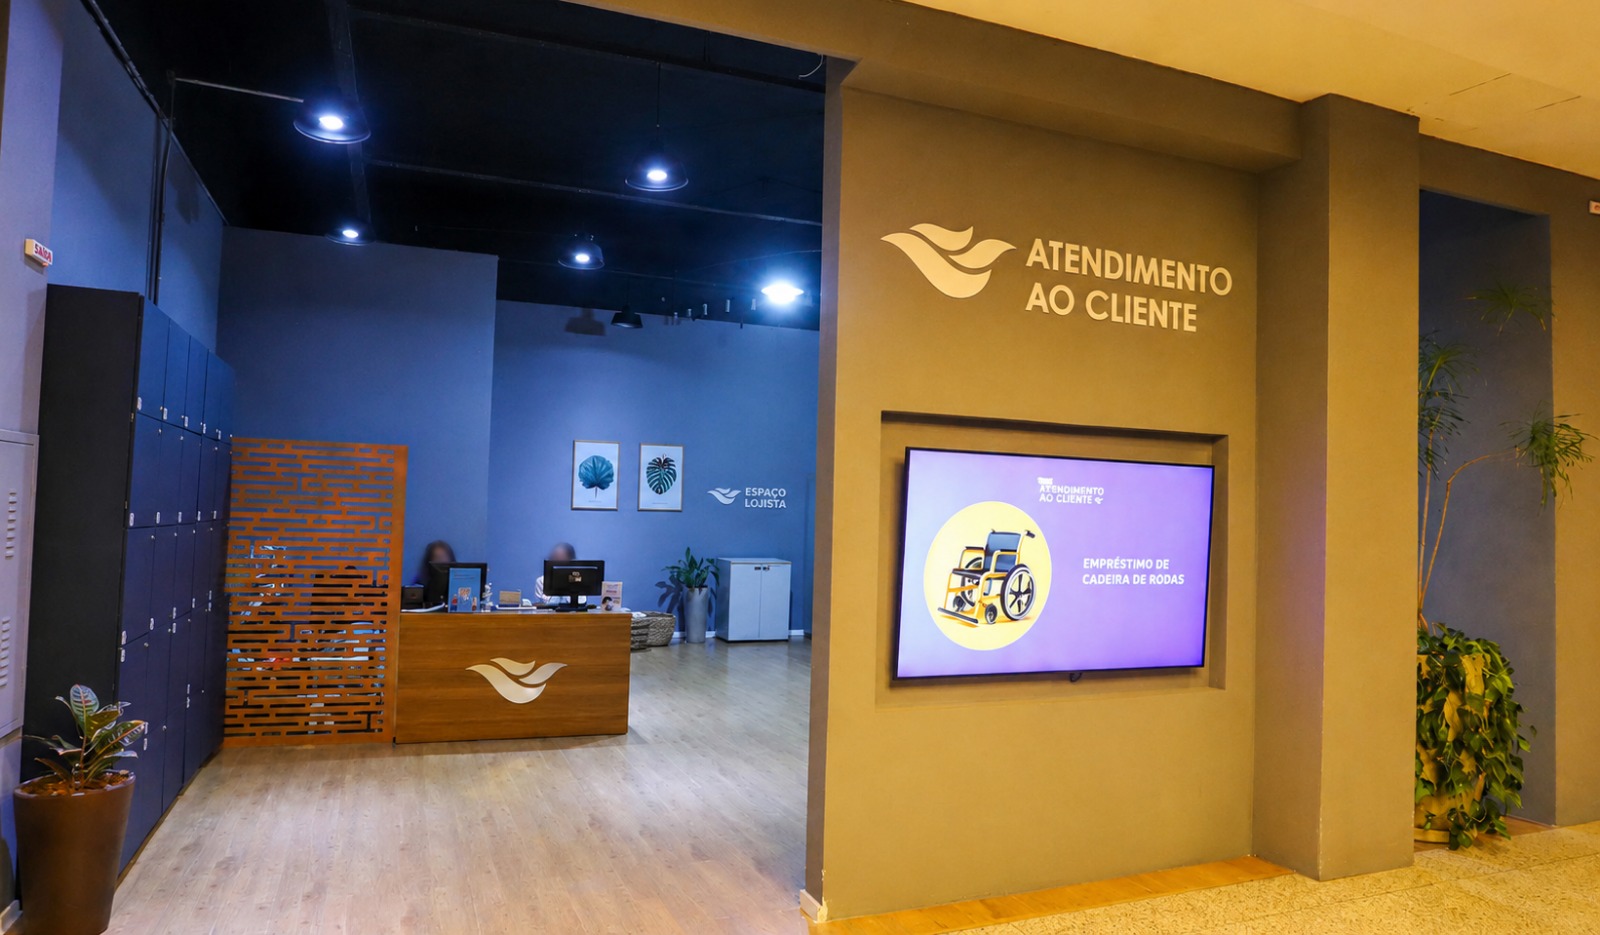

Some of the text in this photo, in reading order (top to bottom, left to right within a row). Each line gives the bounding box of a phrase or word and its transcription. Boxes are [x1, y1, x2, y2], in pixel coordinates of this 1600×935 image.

[1025, 238, 1233, 296] ATENDIMENTO
[1025, 282, 1197, 333] AO CLIENTE
[745, 487, 787, 499] ESPAÇO
[1039, 485, 1105, 496] ATENDIMENTO
[744, 498, 787, 509] LOJISTA
[1039, 493, 1093, 504] AO CLIENTE
[1083, 556, 1170, 570] EMPRÉSTIMO DE
[1082, 574, 1185, 585] CADEIRA DE RODAS
